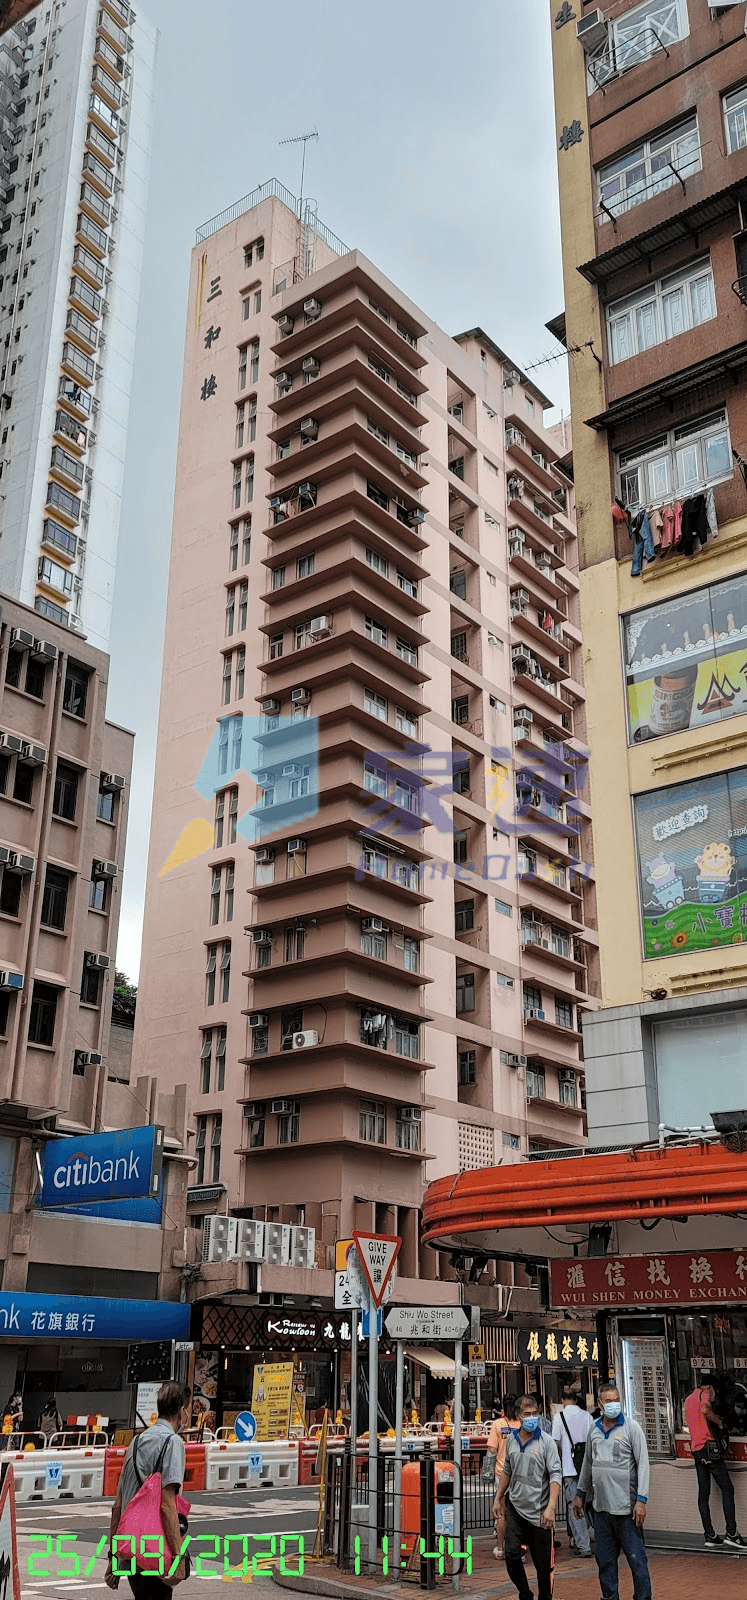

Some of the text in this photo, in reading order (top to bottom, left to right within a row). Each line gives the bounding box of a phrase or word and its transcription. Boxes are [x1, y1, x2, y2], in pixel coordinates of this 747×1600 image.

[655, 808, 705, 838] 歡迎查詢
[53, 1150, 140, 1188] citibank
[368, 1242, 387, 1254] GIVE
[370, 1255, 386, 1265] WAY
[561, 1292, 585, 1303] WUI
[593, 1291, 625, 1302] SHEN
[633, 1288, 681, 1301] MONEY
[30, 1310, 96, 1332] 花旗銀行
[400, 1310, 454, 1319] Shiu Wo Street
[267, 1320, 316, 1336] Kowloon
[410, 1324, 441, 1335] 兆和街
